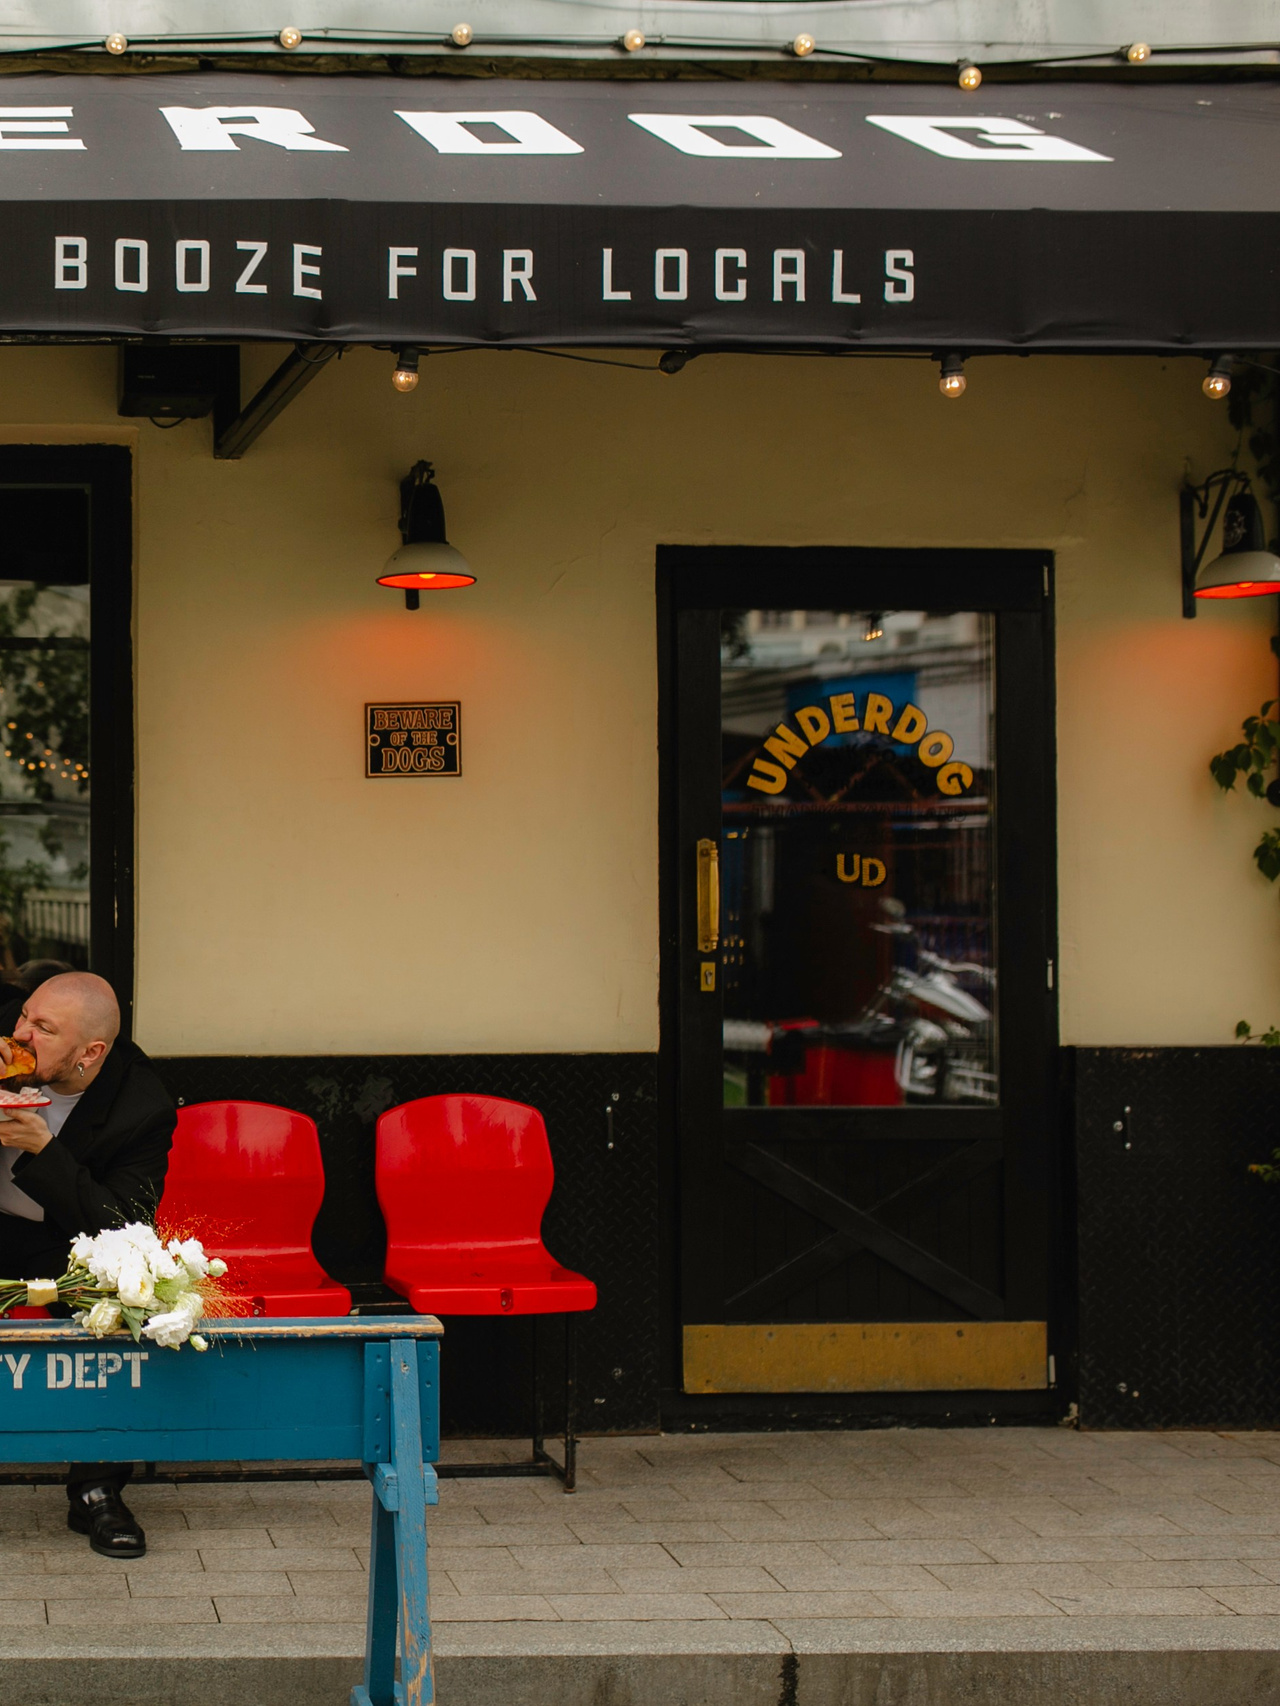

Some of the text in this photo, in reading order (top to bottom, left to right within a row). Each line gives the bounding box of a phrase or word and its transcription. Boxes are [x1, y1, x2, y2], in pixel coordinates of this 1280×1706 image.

[54, 236, 323, 300] BOOZE
[388, 246, 538, 302] FOR
[602, 248, 915, 304] LOCALS
[374, 709, 453, 730] BEWARE
[390, 731, 438, 746] OF THE
[747, 692, 974, 795] UNDERDOG
[381, 746, 445, 772] DOGS
[836, 853, 887, 887] UD
[46, 1352, 149, 1389] DEPT
